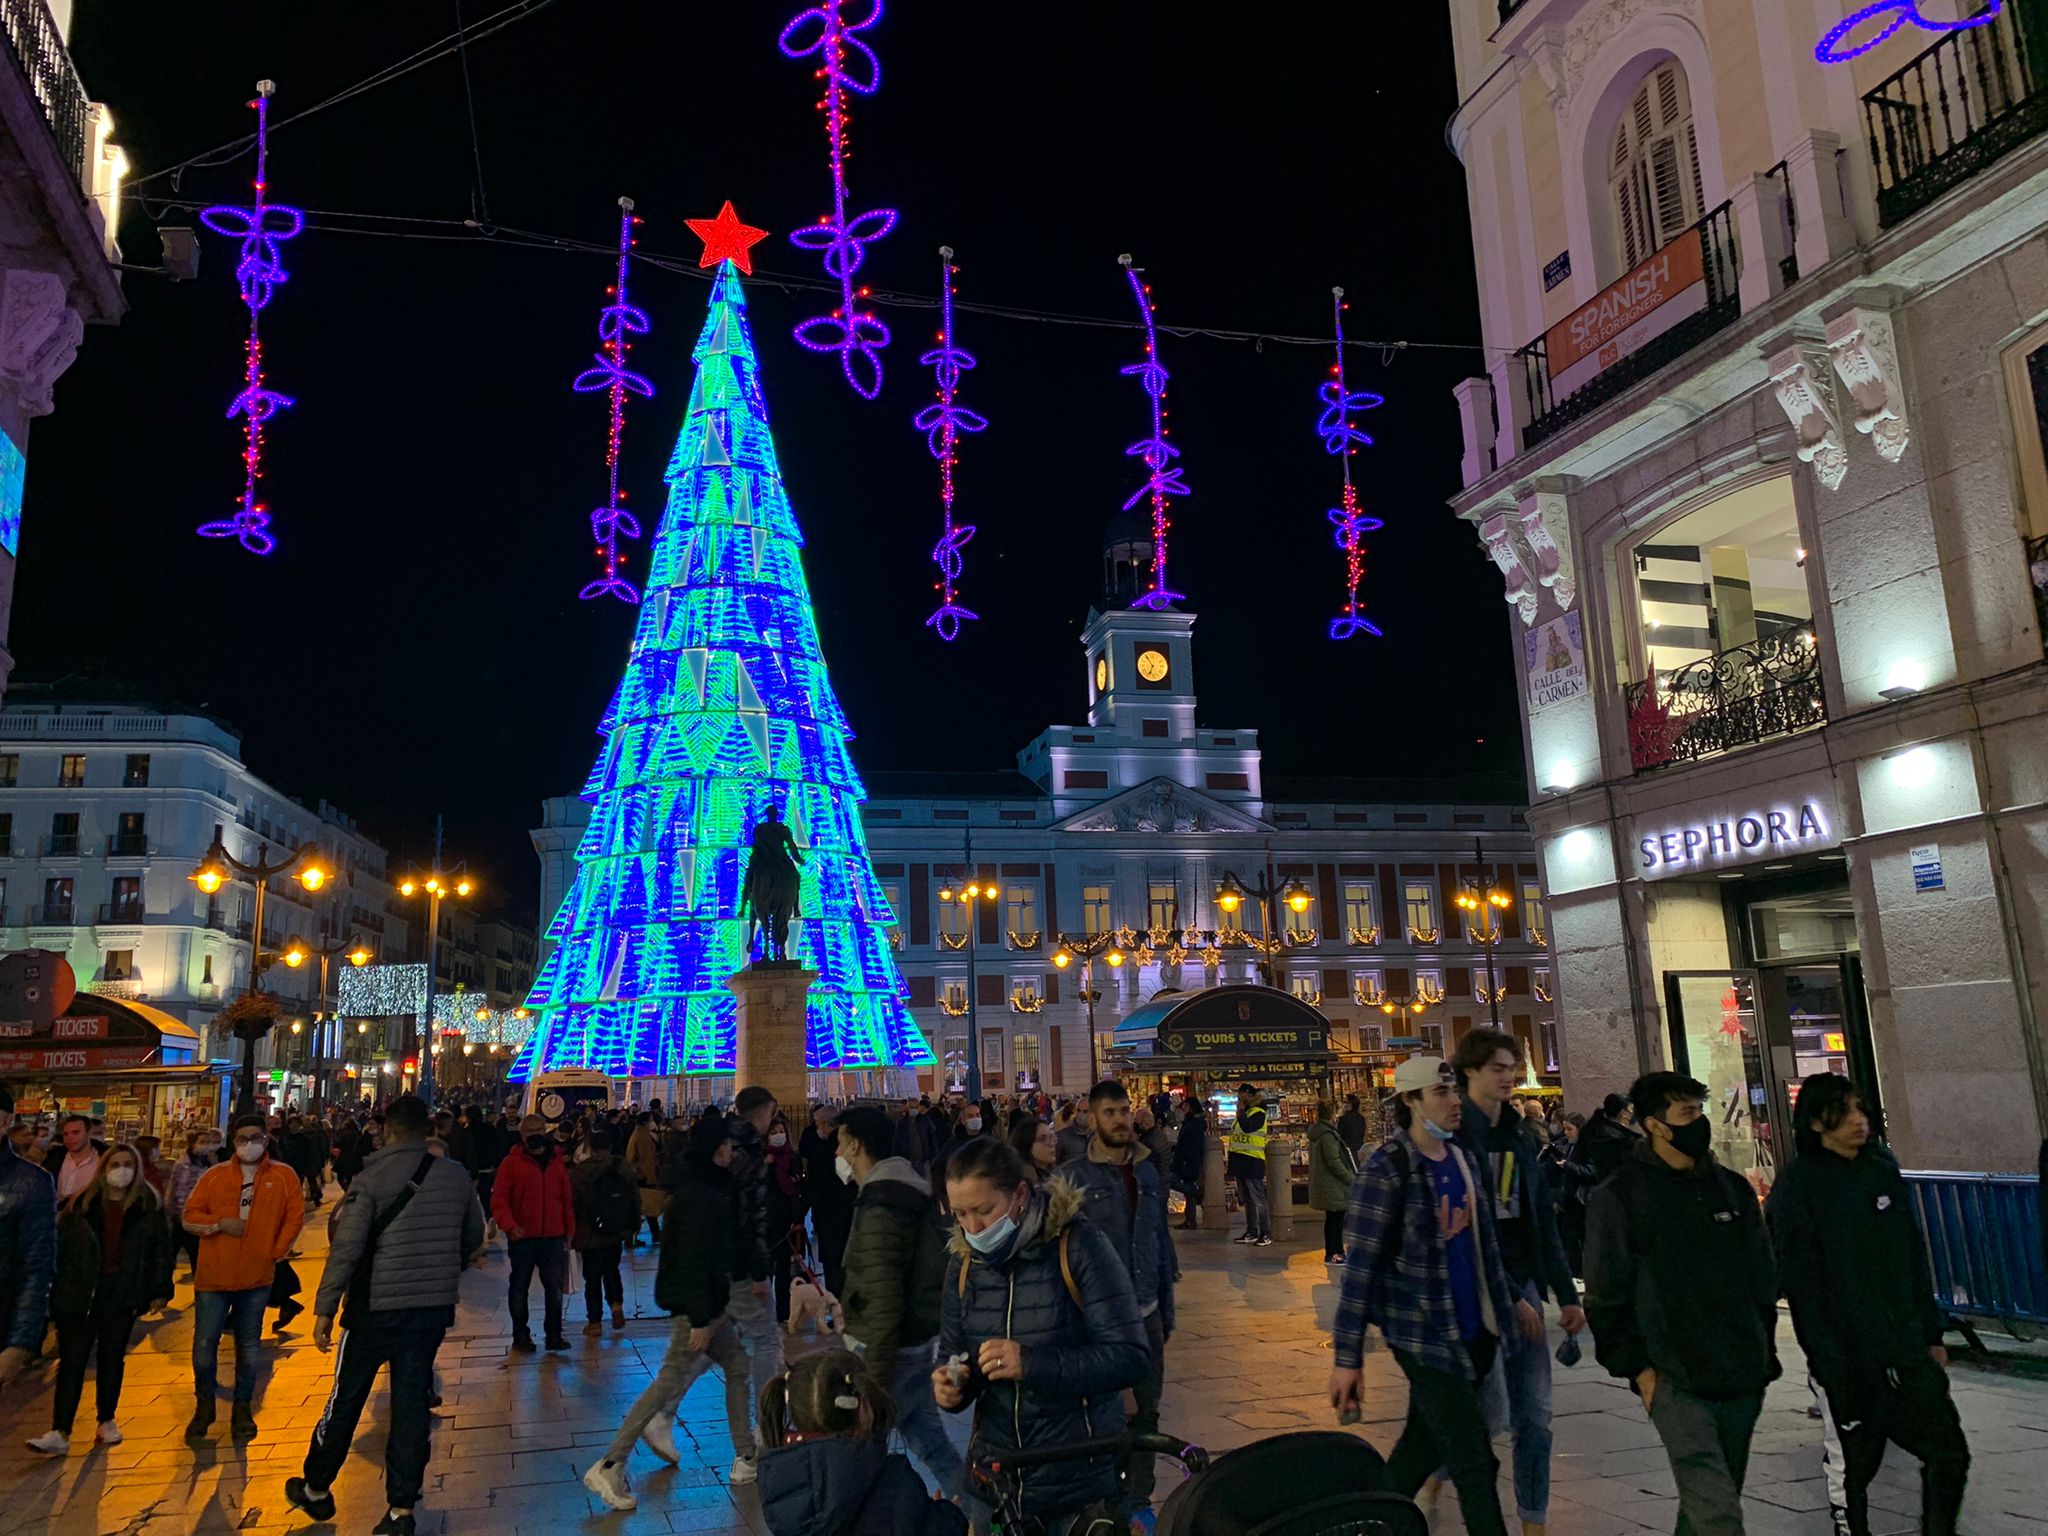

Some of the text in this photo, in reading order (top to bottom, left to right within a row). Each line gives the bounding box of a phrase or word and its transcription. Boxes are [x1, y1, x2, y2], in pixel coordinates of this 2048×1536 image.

[1545, 256, 1565, 273] CALLE
[1571, 255, 1670, 345] SPANISH
[1579, 334, 1601, 355] FOR
[1600, 289, 1664, 341] FOREIGNERS
[1534, 666, 1579, 691] CALLE DEL
[1538, 679, 1579, 706] CARMEN
[1640, 803, 1826, 867] SEPHORA
[55, 1019, 99, 1036] TICKETS
[1194, 1032, 1298, 1044] TOURS & TICKETS
[43, 1051, 87, 1068] TICKETS
[1267, 1063, 1305, 1072] TICKETS
